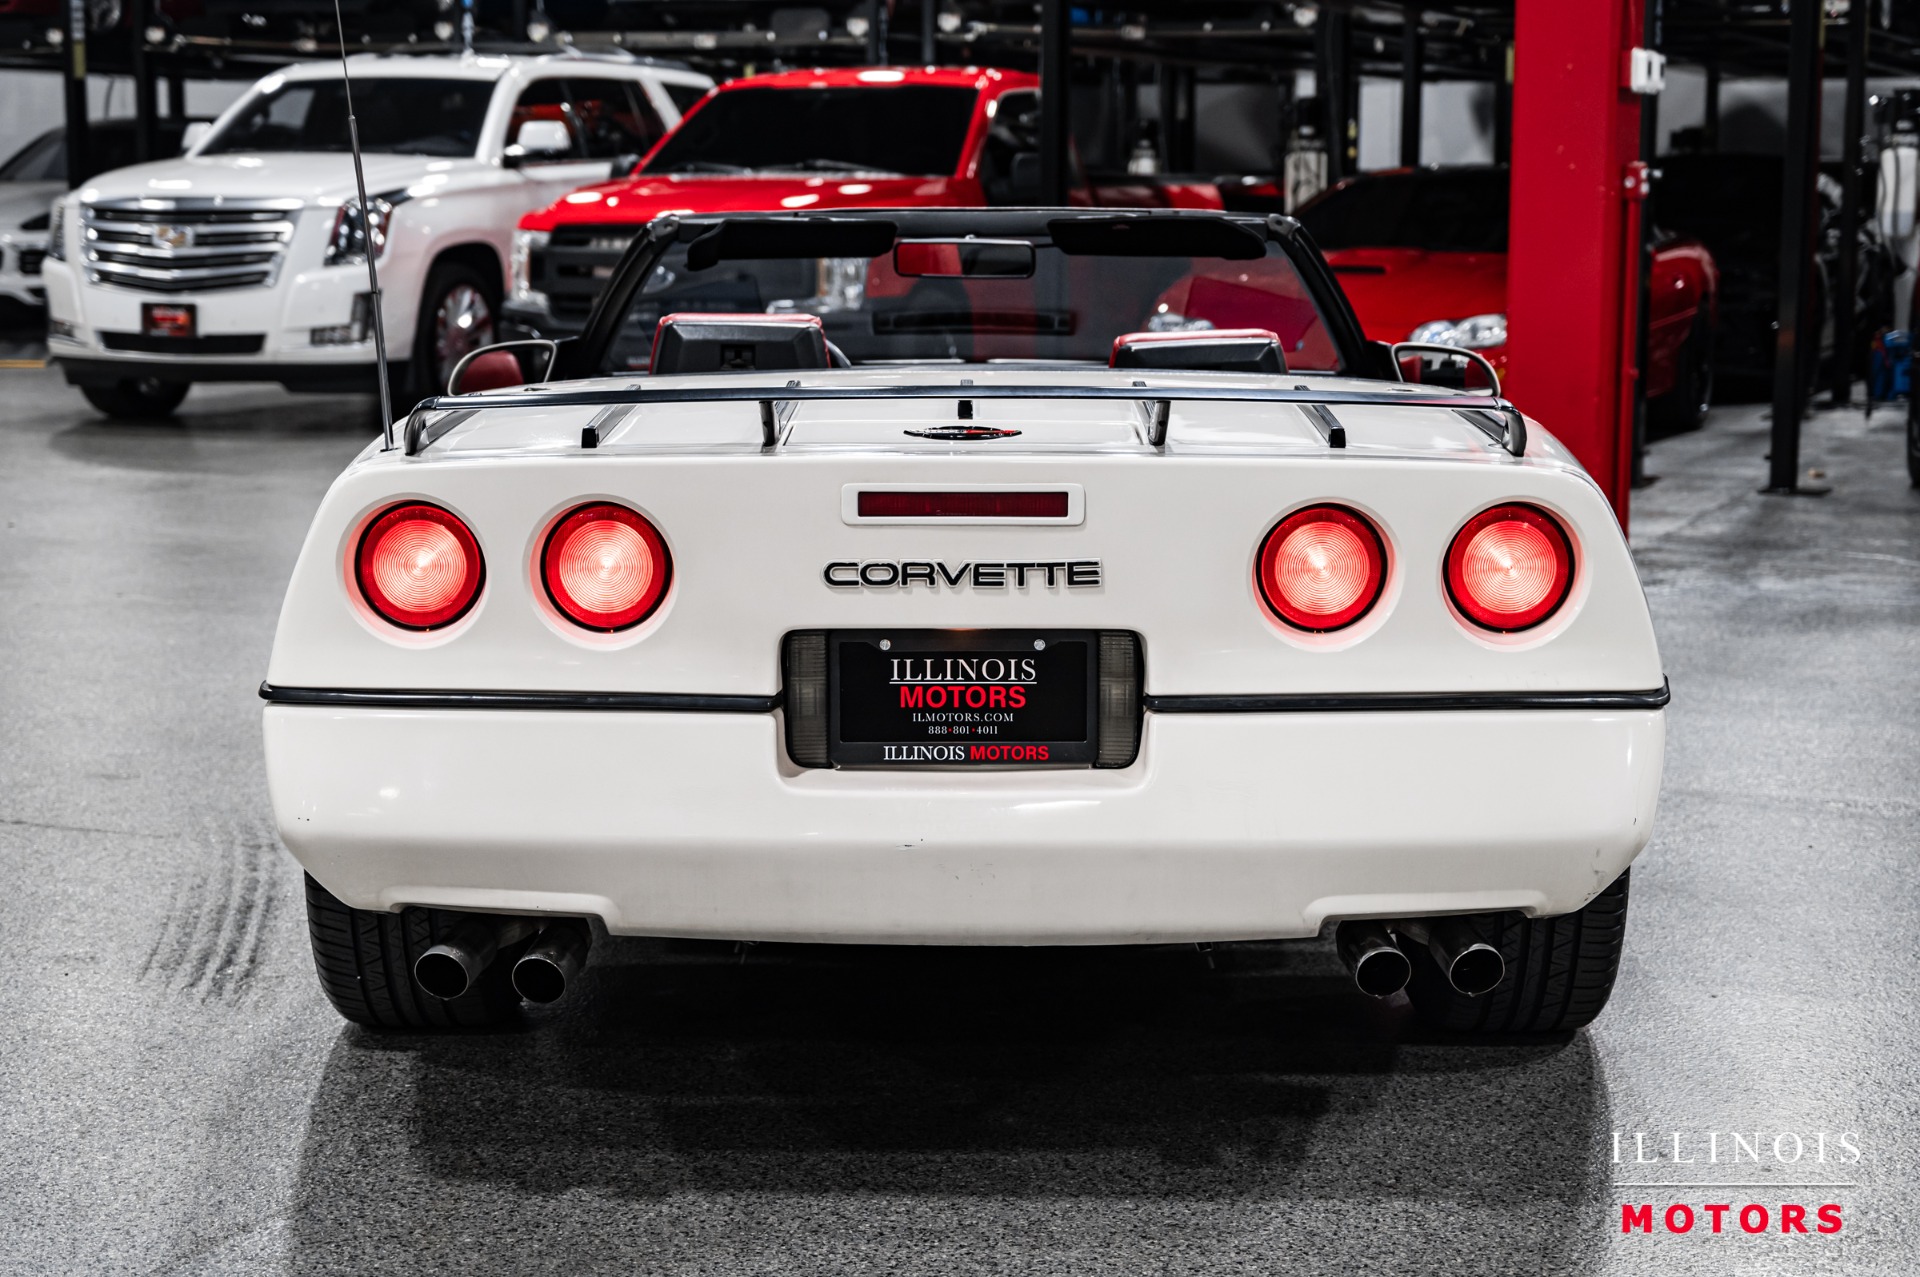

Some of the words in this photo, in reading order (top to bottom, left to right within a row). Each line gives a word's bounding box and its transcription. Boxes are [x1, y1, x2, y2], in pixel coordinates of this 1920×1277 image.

[821, 559, 1102, 588] CORVETTE
[890, 658, 1037, 681] ILLINOIS
[900, 685, 1027, 709] MOTORS
[912, 712, 1014, 723] ILMOTORS.COM
[883, 745, 965, 761] ILLINOIS
[970, 745, 1050, 761] MOTORS
